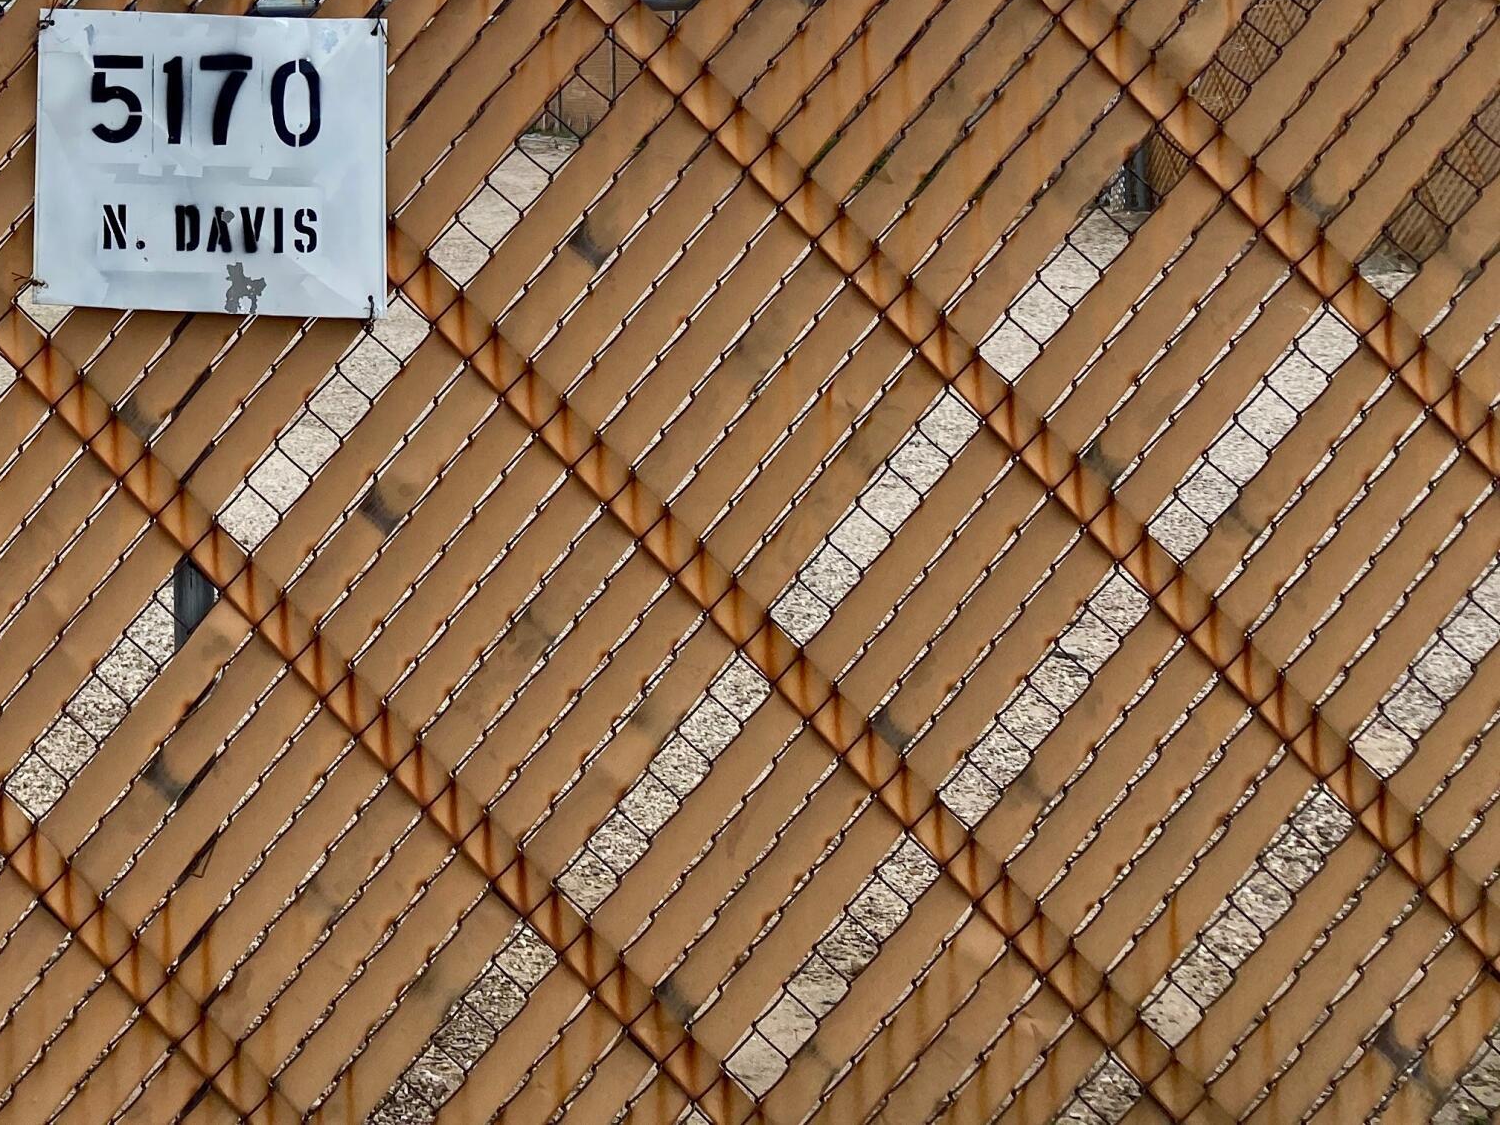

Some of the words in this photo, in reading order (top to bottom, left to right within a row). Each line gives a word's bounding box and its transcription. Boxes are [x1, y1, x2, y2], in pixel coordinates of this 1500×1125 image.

[91, 55, 321, 148] 5170
[103, 204, 146, 250] N.
[175, 204, 318, 254] DAVIS
